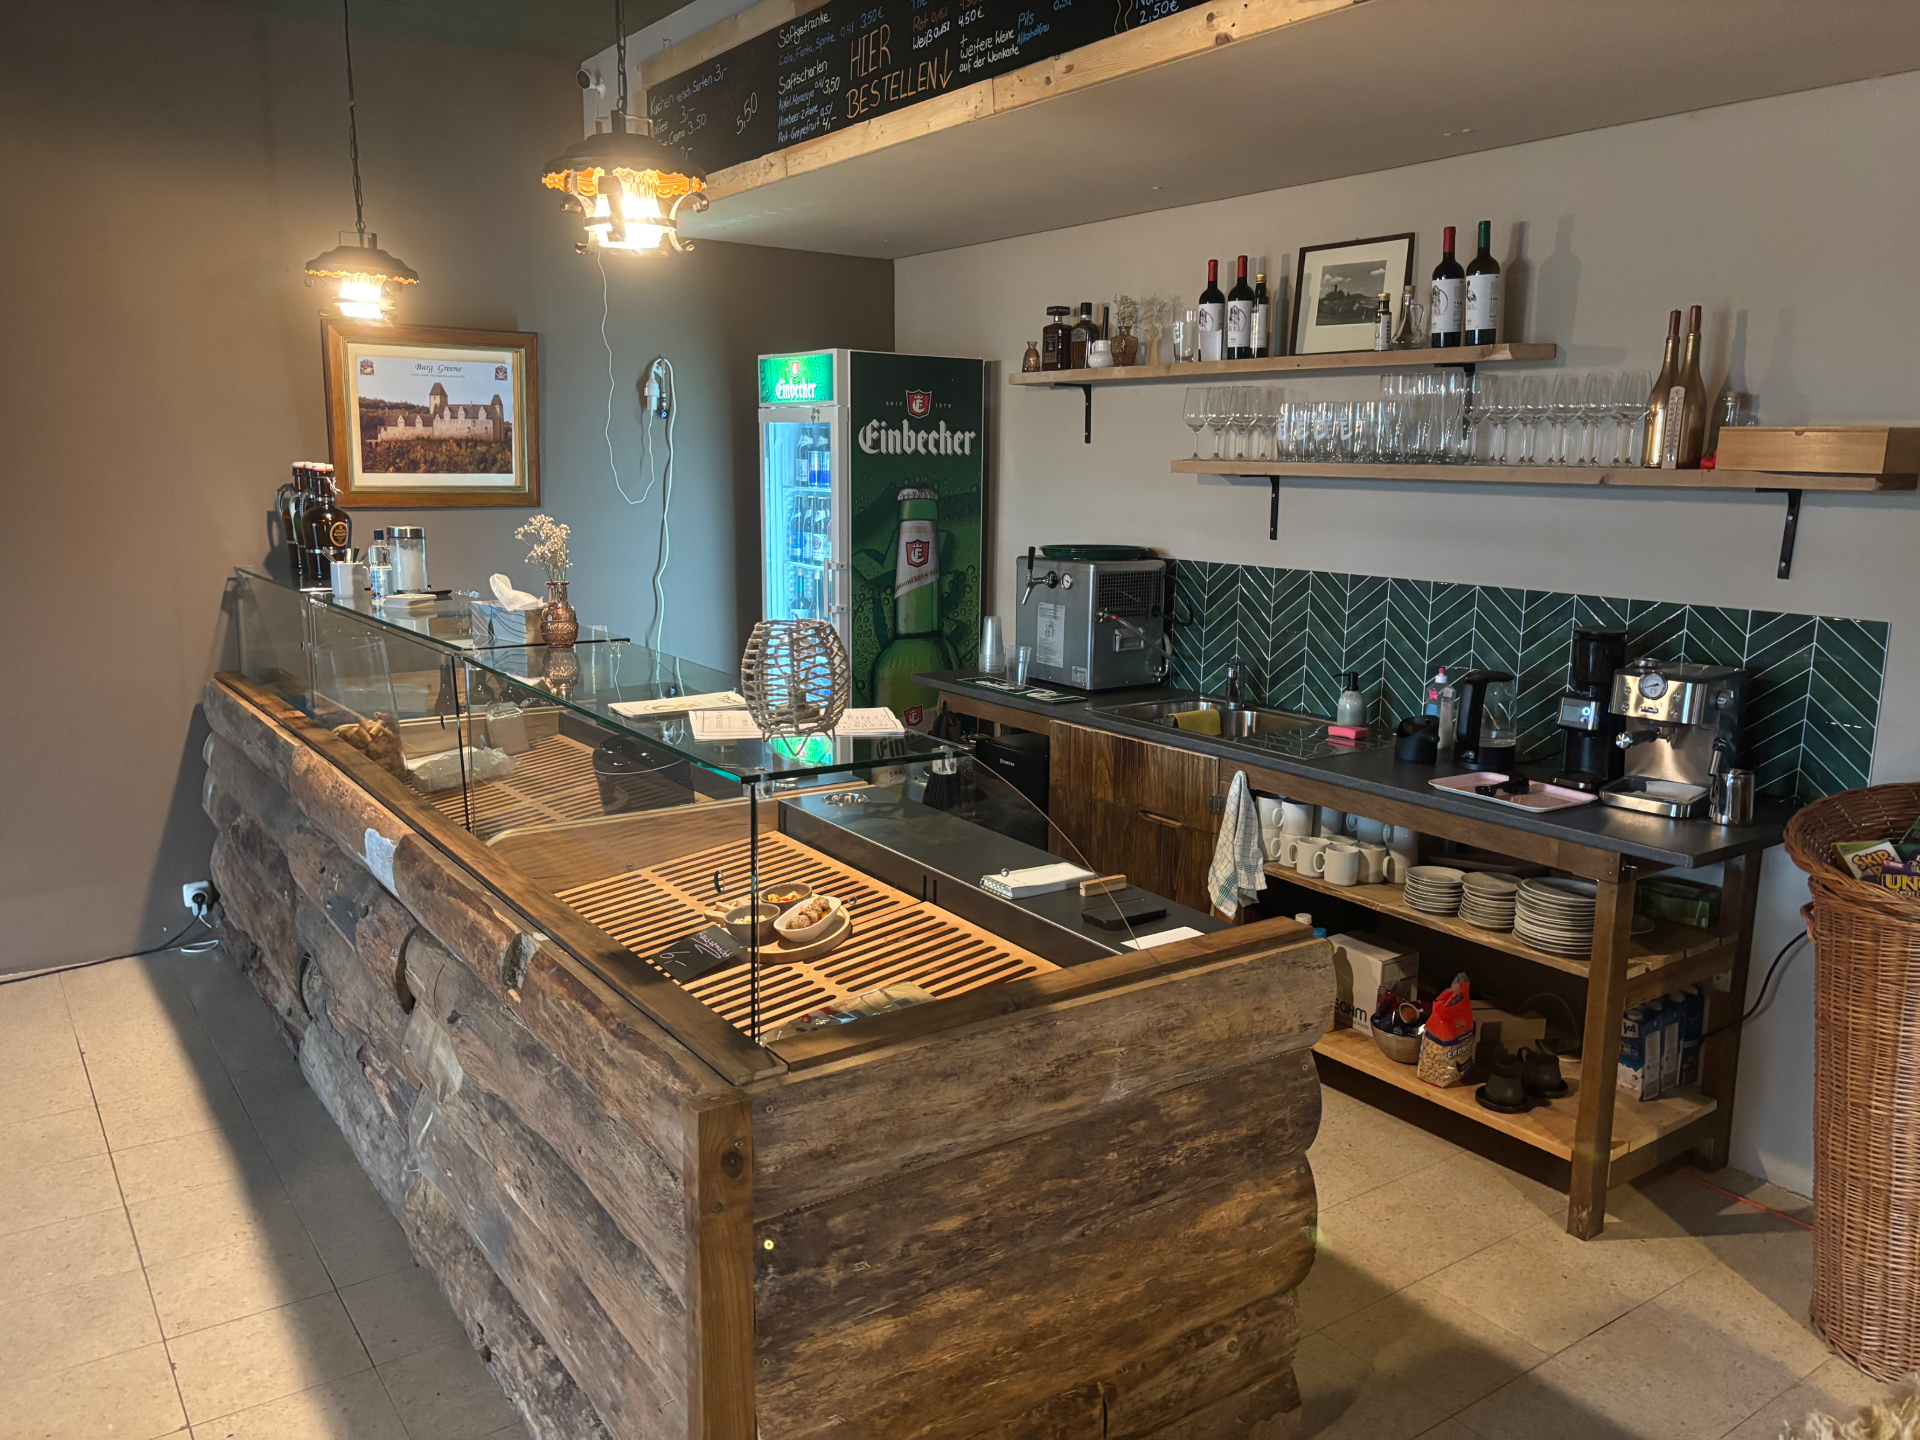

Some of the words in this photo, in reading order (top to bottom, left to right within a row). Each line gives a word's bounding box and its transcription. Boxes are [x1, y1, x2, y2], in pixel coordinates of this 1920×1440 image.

[913, 13, 928, 32] Rot
[1018, 10, 1034, 30] Pils
[850, 24, 891, 80] HIER
[959, 58, 971, 73] auf
[973, 54, 986, 69] der
[845, 57, 938, 119] BESTELLEN
[736, 91, 758, 135] 5,50
[415, 363, 433, 373] Burg
[437, 364, 462, 374] Greene
[775, 377, 817, 400] Einbecker
[858, 418, 977, 457] Einbecker
[1623, 1022, 1636, 1034] ja!
